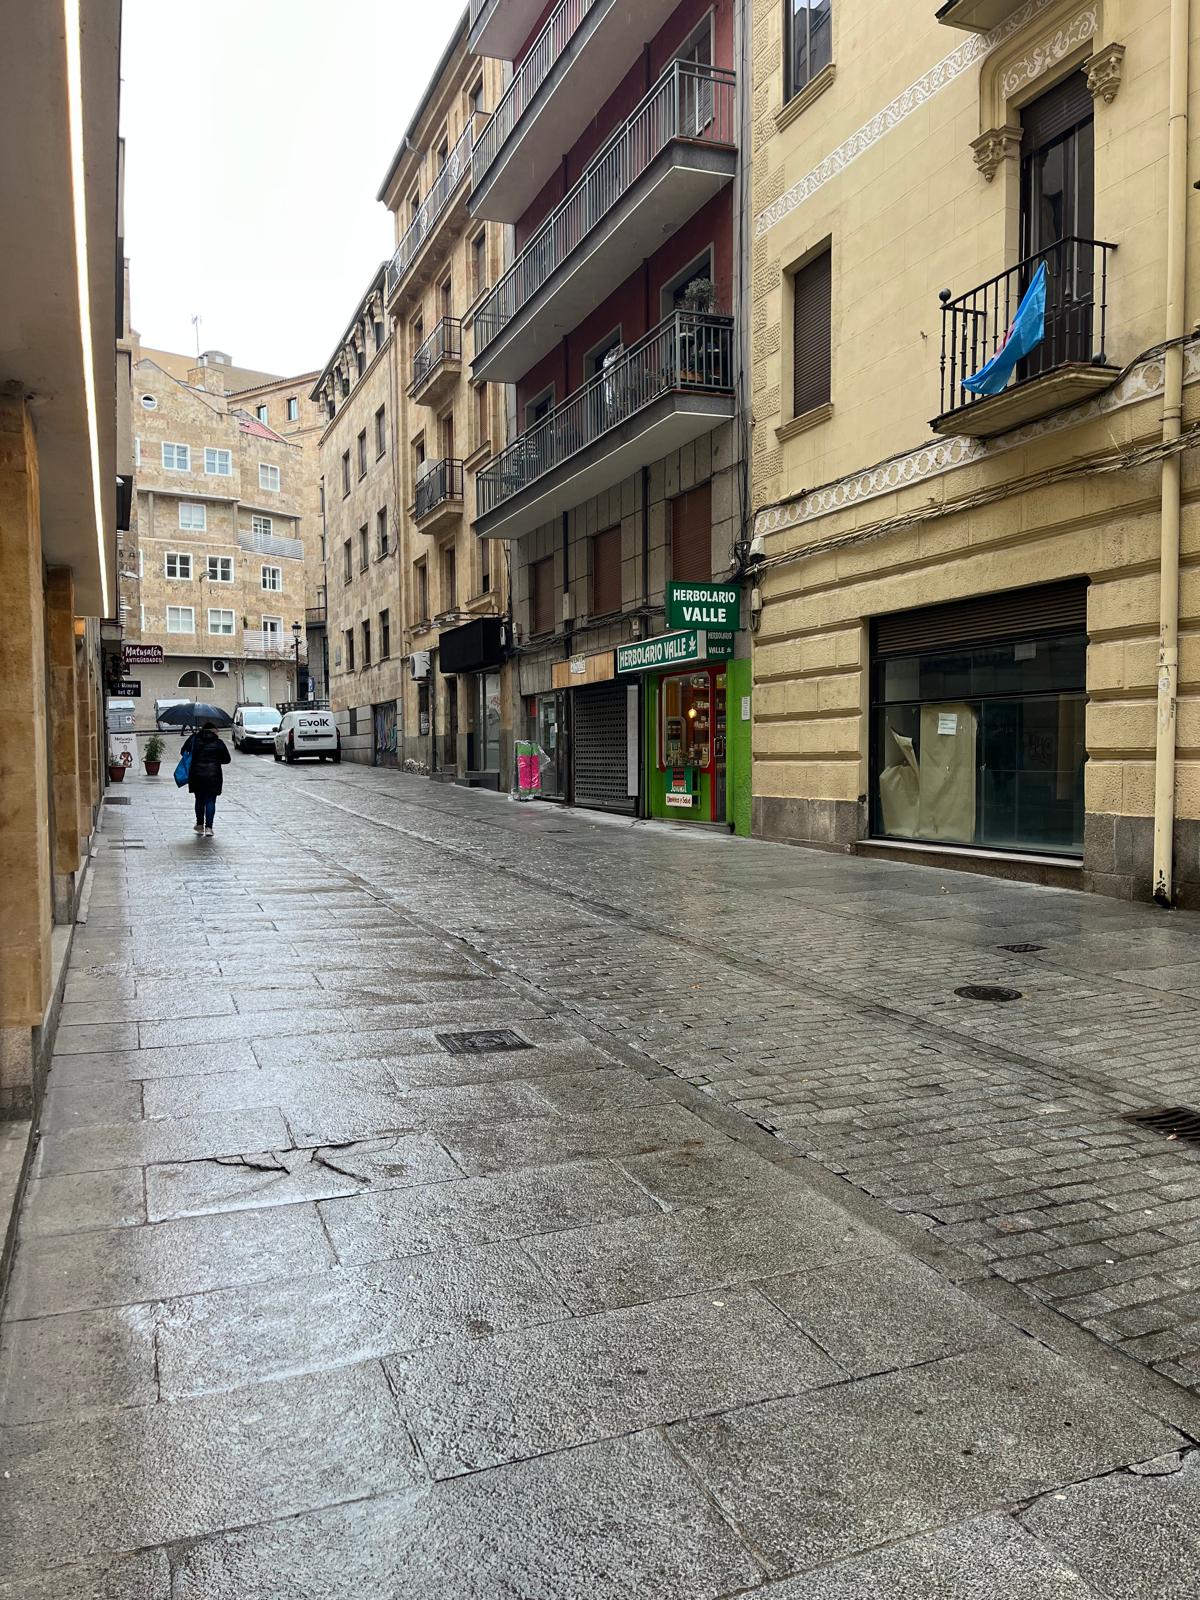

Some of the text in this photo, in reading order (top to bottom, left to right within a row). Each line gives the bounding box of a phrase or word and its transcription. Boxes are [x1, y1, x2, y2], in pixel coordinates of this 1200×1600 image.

[673, 589, 736, 604] HERBOLARIO
[682, 607, 727, 622] VALLE
[707, 632, 732, 640] HERBOLARIO
[125, 646, 162, 657] Matusalén
[619, 637, 687, 669] HERBOLARIO VALLE
[708, 646, 725, 654] VALLE
